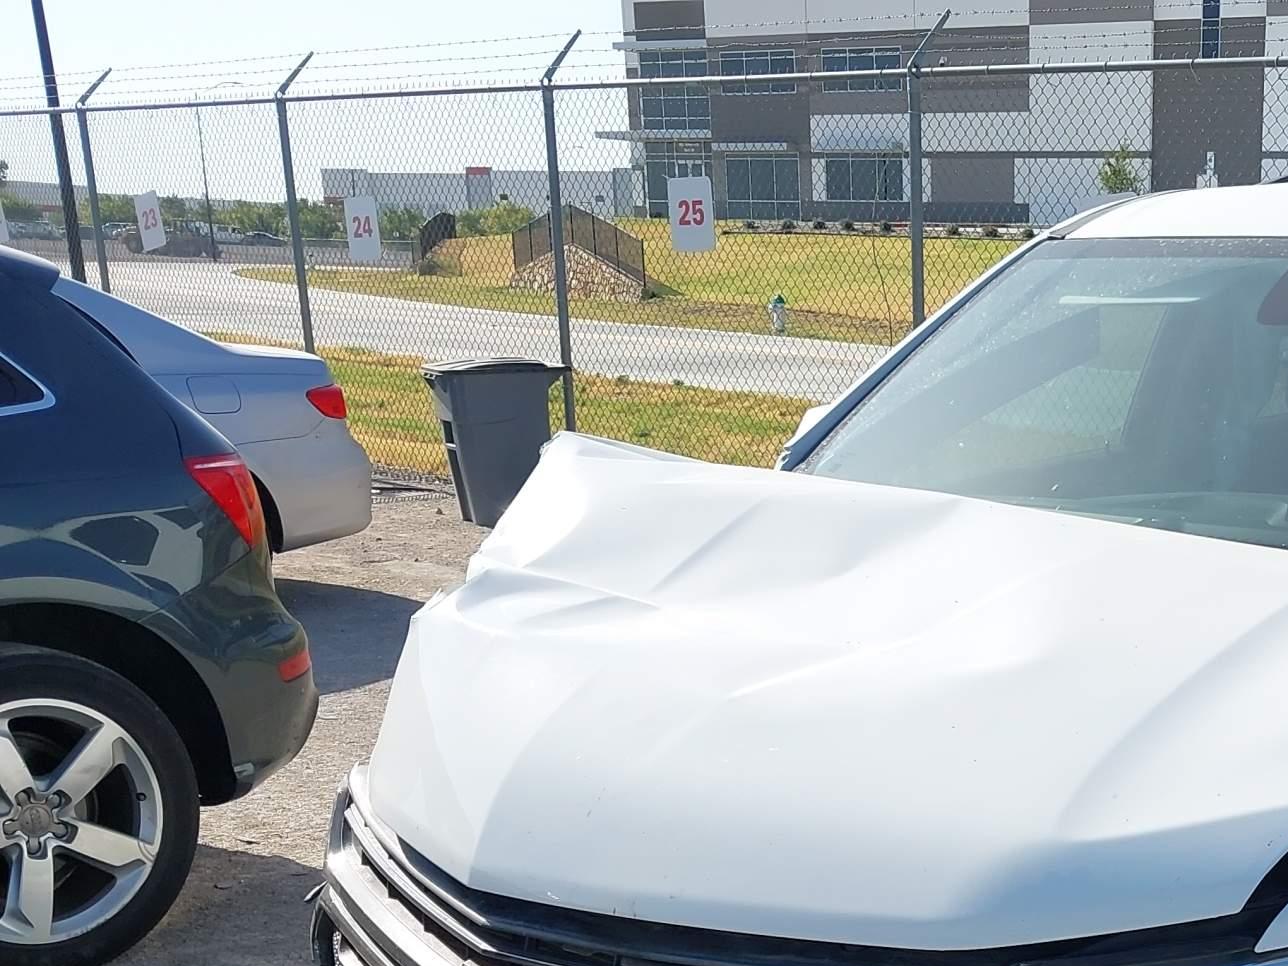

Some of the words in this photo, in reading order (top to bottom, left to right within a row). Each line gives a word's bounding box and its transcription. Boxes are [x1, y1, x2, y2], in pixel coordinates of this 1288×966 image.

[142, 208, 157, 230] 23
[678, 200, 705, 226] 25
[352, 216, 373, 238] 24
